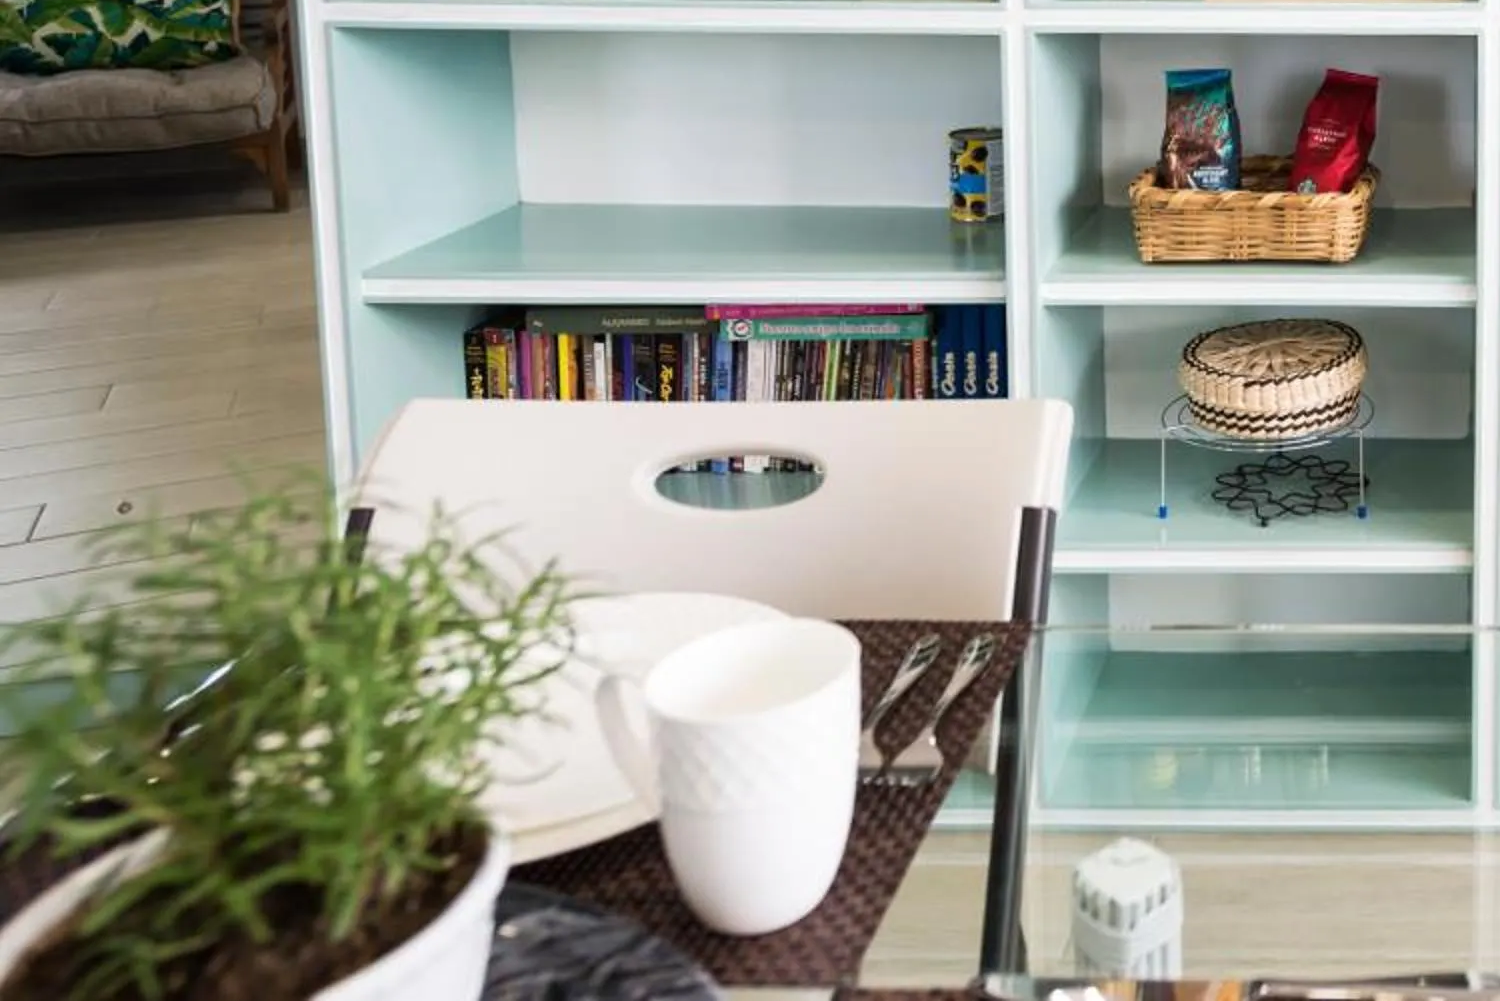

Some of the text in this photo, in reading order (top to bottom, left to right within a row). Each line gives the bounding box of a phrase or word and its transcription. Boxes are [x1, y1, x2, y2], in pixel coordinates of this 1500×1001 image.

[940, 350, 956, 396] Oasis
[963, 350, 977, 396] Oasis
[985, 350, 999, 396] Oasis
